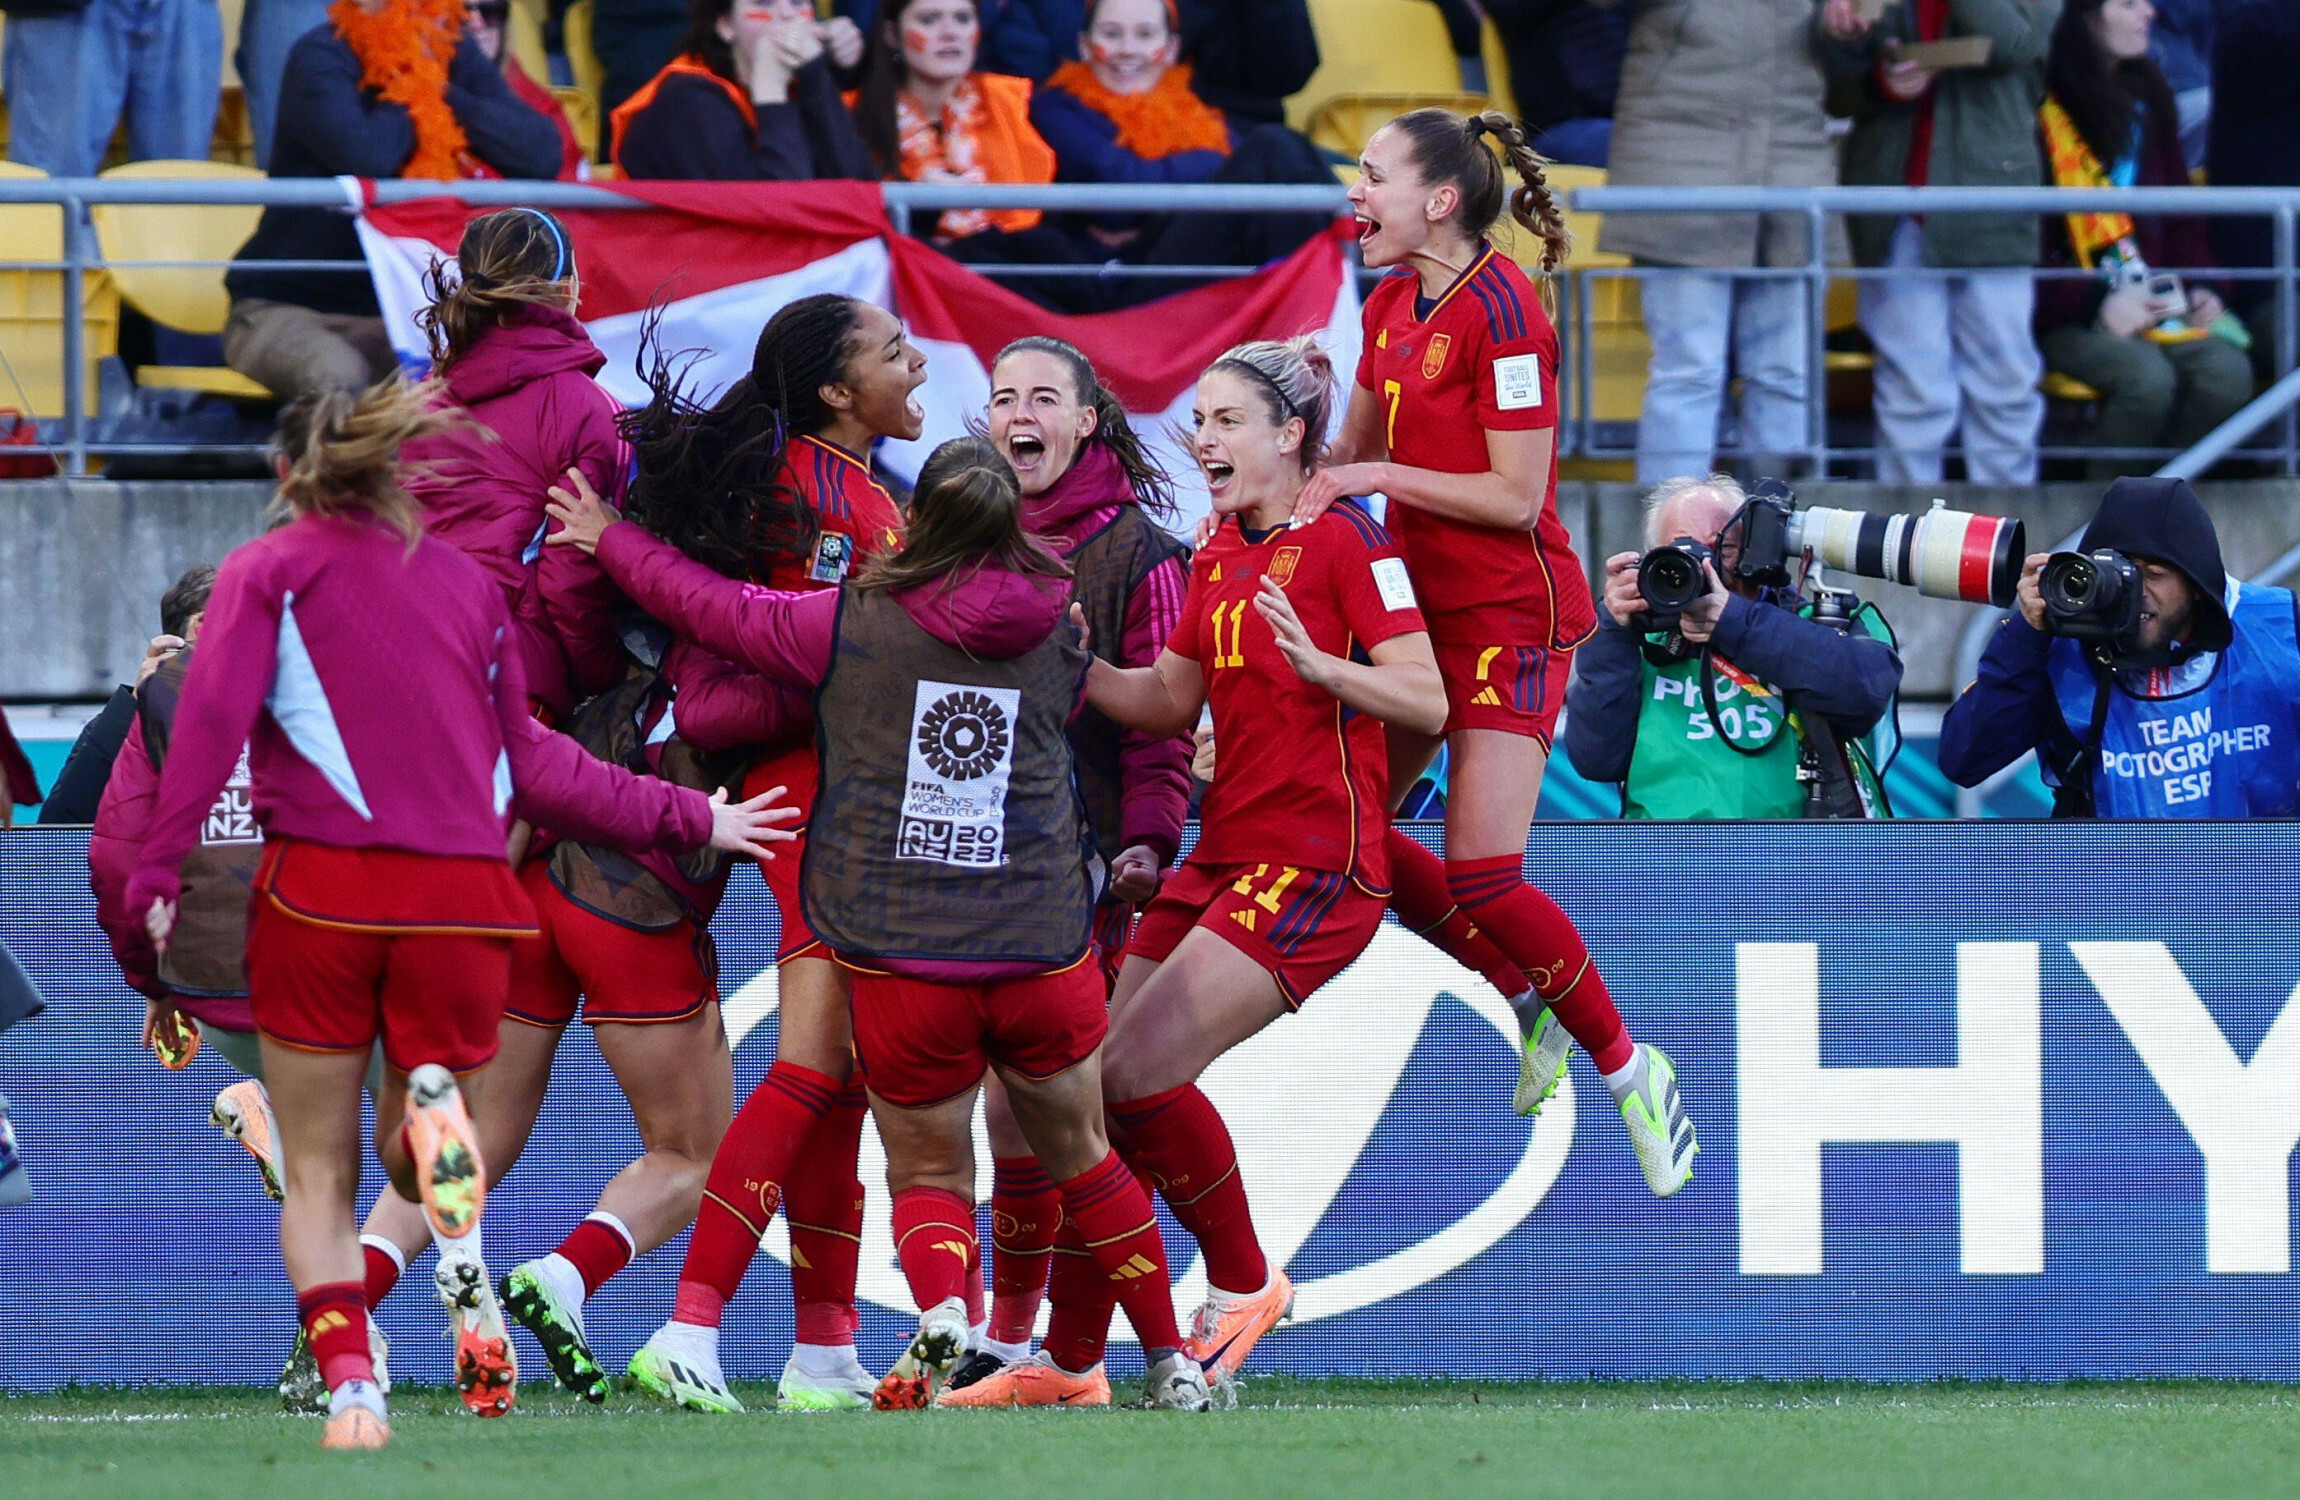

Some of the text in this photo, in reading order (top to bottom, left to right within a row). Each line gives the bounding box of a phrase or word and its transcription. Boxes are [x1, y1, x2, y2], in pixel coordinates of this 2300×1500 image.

[1504, 371, 1530, 382] UNITES
[1384, 379, 1401, 450] 7
[1211, 599, 1247, 669] 11
[1686, 703, 1773, 740] 505
[2138, 706, 2212, 747] TEAM
[910, 791, 975, 808] WOMEN'S
[911, 781, 945, 794] FIFA
[2163, 770, 2212, 805] ESP
[908, 802, 985, 818] WORLD CUP
[208, 813, 254, 838] NZ
[904, 820, 999, 844] AU 20
[902, 840, 996, 863] NZ 23
[1551, 958, 1565, 974] 09
[1735, 940, 2300, 1275] HY
[743, 1178, 759, 1192] 19
